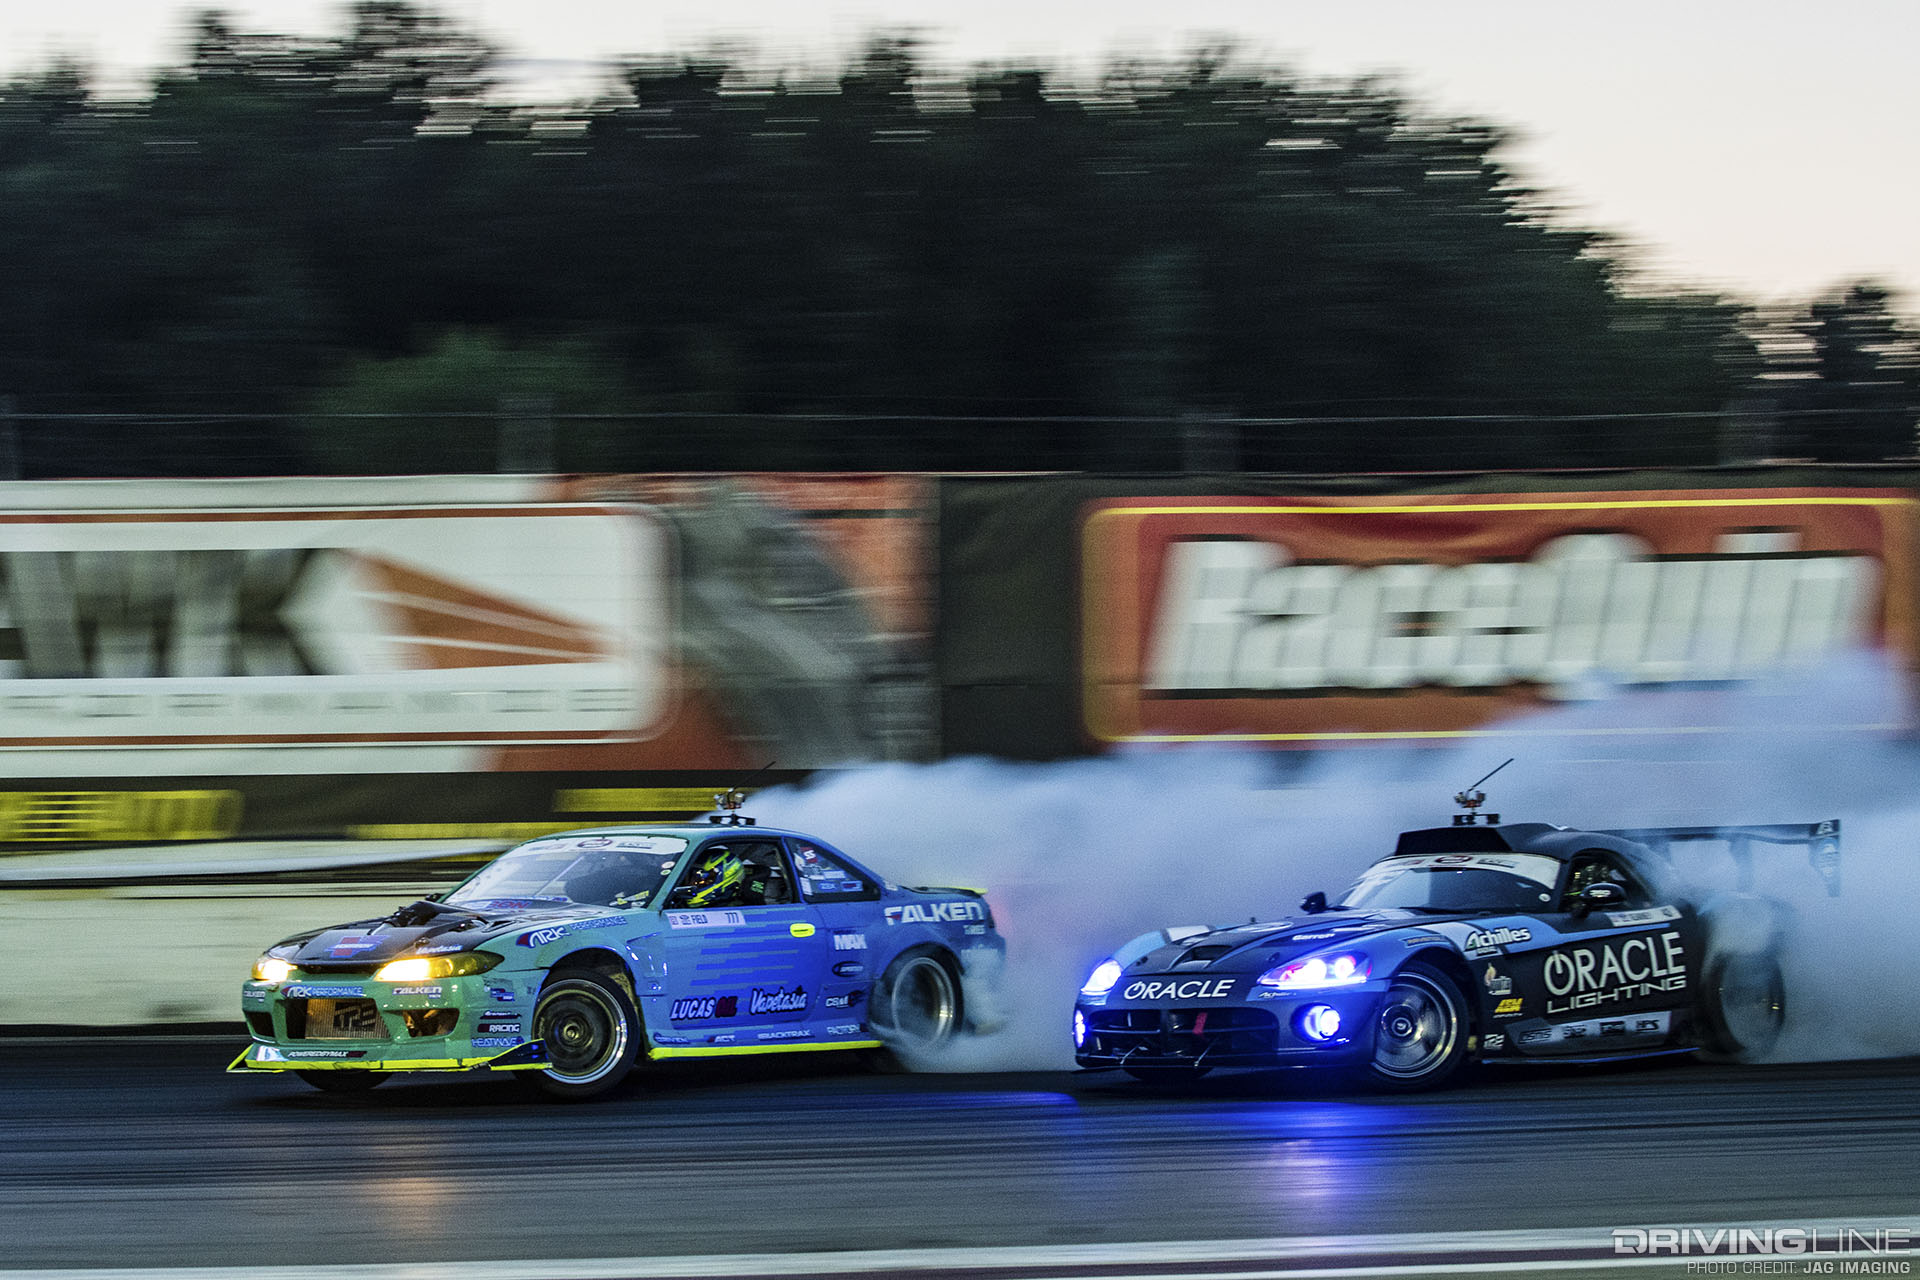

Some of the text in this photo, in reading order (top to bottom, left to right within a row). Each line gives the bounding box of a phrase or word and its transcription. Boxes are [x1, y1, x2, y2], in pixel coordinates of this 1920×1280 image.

[884, 902, 984, 925] FALKEN
[529, 926, 570, 948] ARK
[1466, 927, 1531, 949] Achilles
[1544, 932, 1686, 996] ORACLE
[286, 986, 363, 997] ARK PERFORMANCE
[392, 986, 442, 995] FALKEN
[1124, 979, 1236, 1000] ORACLE
[1547, 975, 1687, 1014] LIGHTING
[671, 999, 715, 1020] LUCAS
[489, 1024, 520, 1033] RACING
